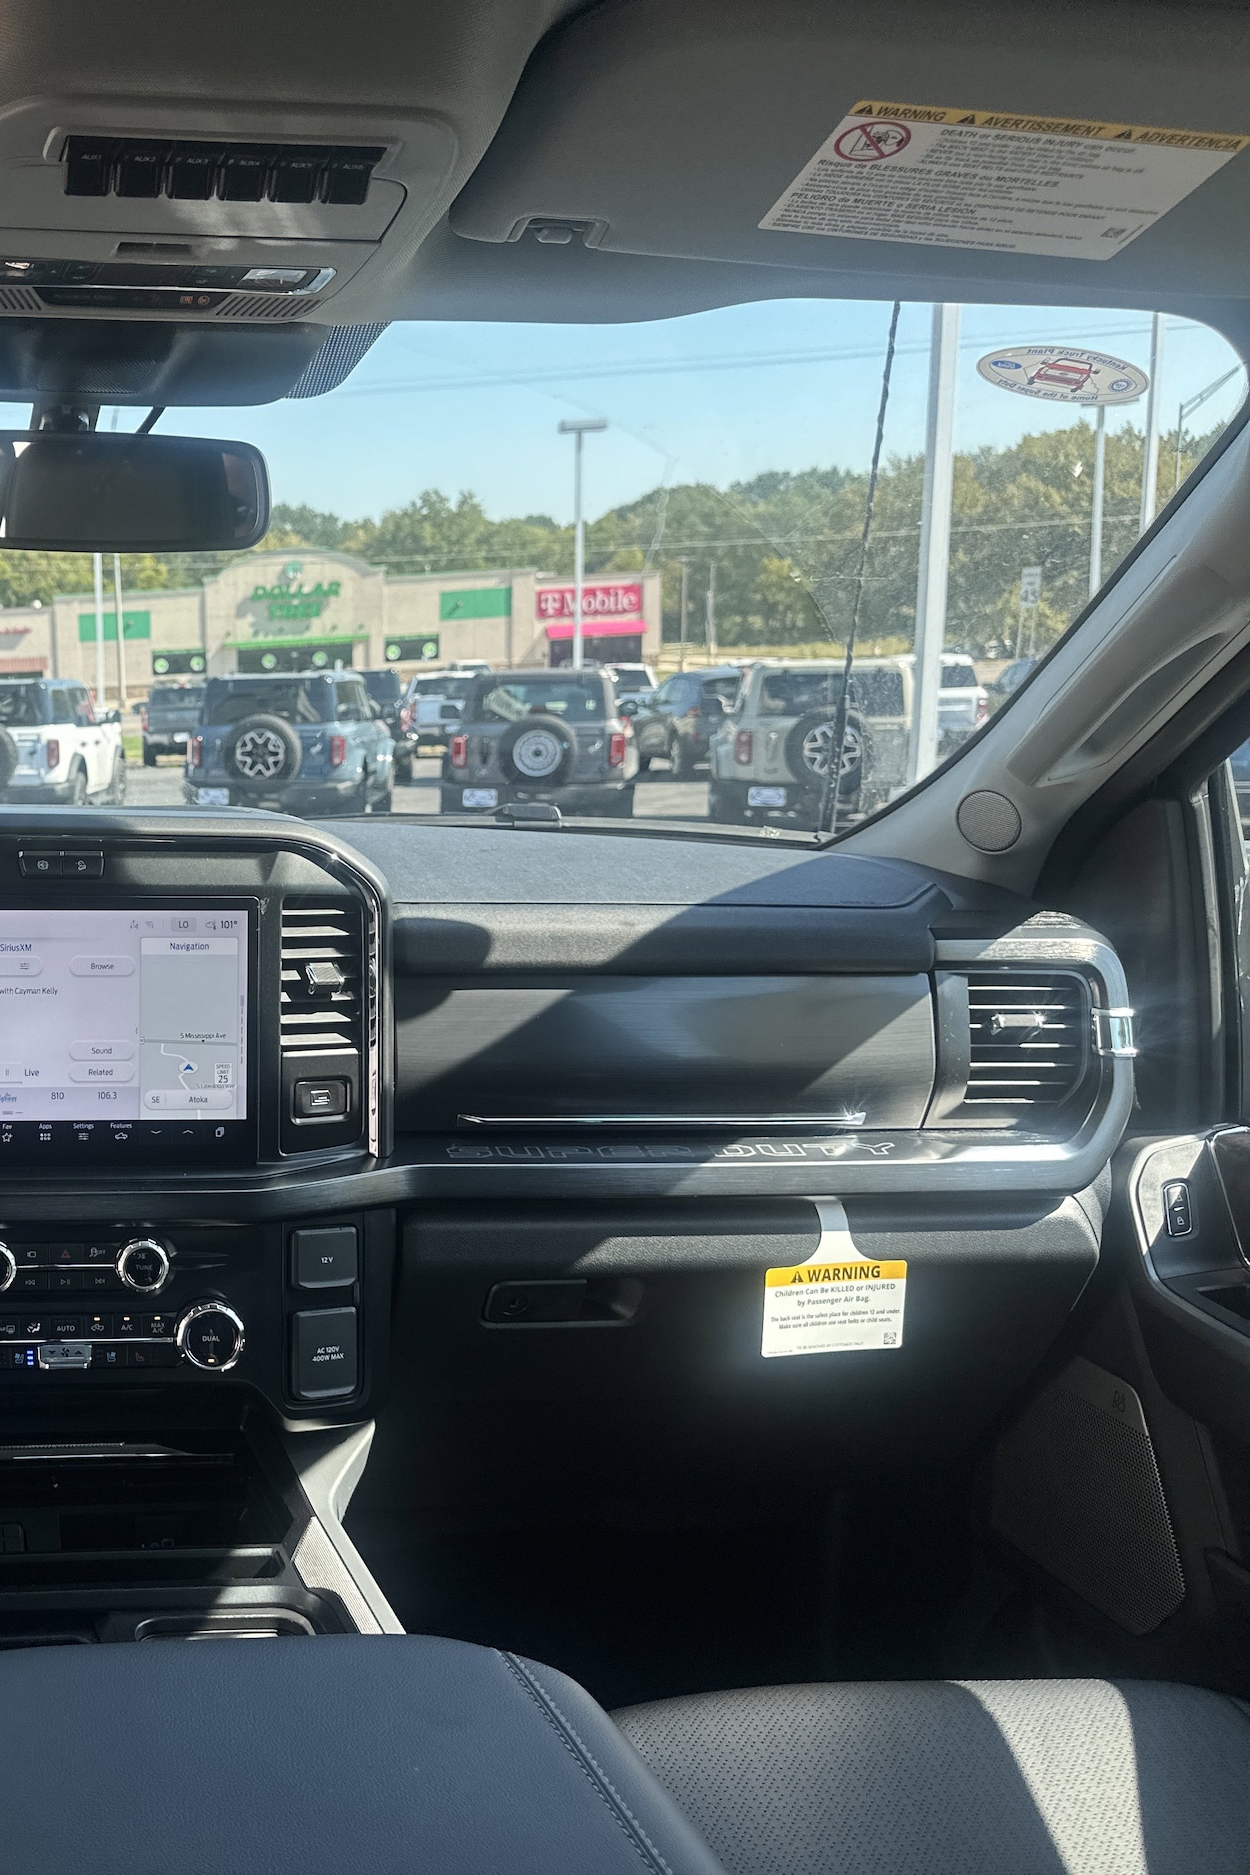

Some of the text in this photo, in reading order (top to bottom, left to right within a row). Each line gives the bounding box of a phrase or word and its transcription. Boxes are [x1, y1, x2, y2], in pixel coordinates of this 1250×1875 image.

[876, 106, 947, 121] WARNING
[980, 116, 1106, 136] AVERTISSEMENT
[1135, 132, 1243, 150] ADVERTENCIA
[940, 129, 977, 138] DEATH
[992, 134, 1042, 144] SERIOUS
[1042, 138, 1083, 147] INJURY
[870, 164, 933, 176] BLESSURES
[935, 171, 979, 180] GRAVES
[994, 176, 1059, 187] MORTELLES
[251, 581, 341, 602] DOLLAR
[563, 588, 637, 615] Mobile
[178, 920, 189, 928] LO
[220, 920, 238, 929] 101°
[0, 943, 32, 952] SiriusXM
[169, 942, 210, 951] Navigation
[0, 987, 13, 995] with
[14, 987, 41, 996] Cayman
[42, 987, 58, 996] Kelly
[185, 1032, 215, 1040] Mississippi
[91, 1047, 113, 1055] Sound
[24, 1068, 40, 1077] Live
[88, 1068, 113, 1076] Related
[217, 1075, 228, 1083] 25
[51, 1092, 65, 1100] 810
[97, 1091, 117, 1100] 106.3
[38, 1123, 52, 1131] Apps
[73, 1122, 94, 1131] Settings
[110, 1122, 132, 1130] Features
[446, 1141, 896, 1159] SUPER DUTY
[807, 1265, 881, 1283] WARNING
[865, 1283, 896, 1292] INJURED
[797, 1299, 805, 1307] by
[807, 1297, 842, 1306] Passenger
[856, 1295, 870, 1303] Bag.
[121, 1323, 133, 1331] A/C
[312, 1354, 330, 1362] 400W
